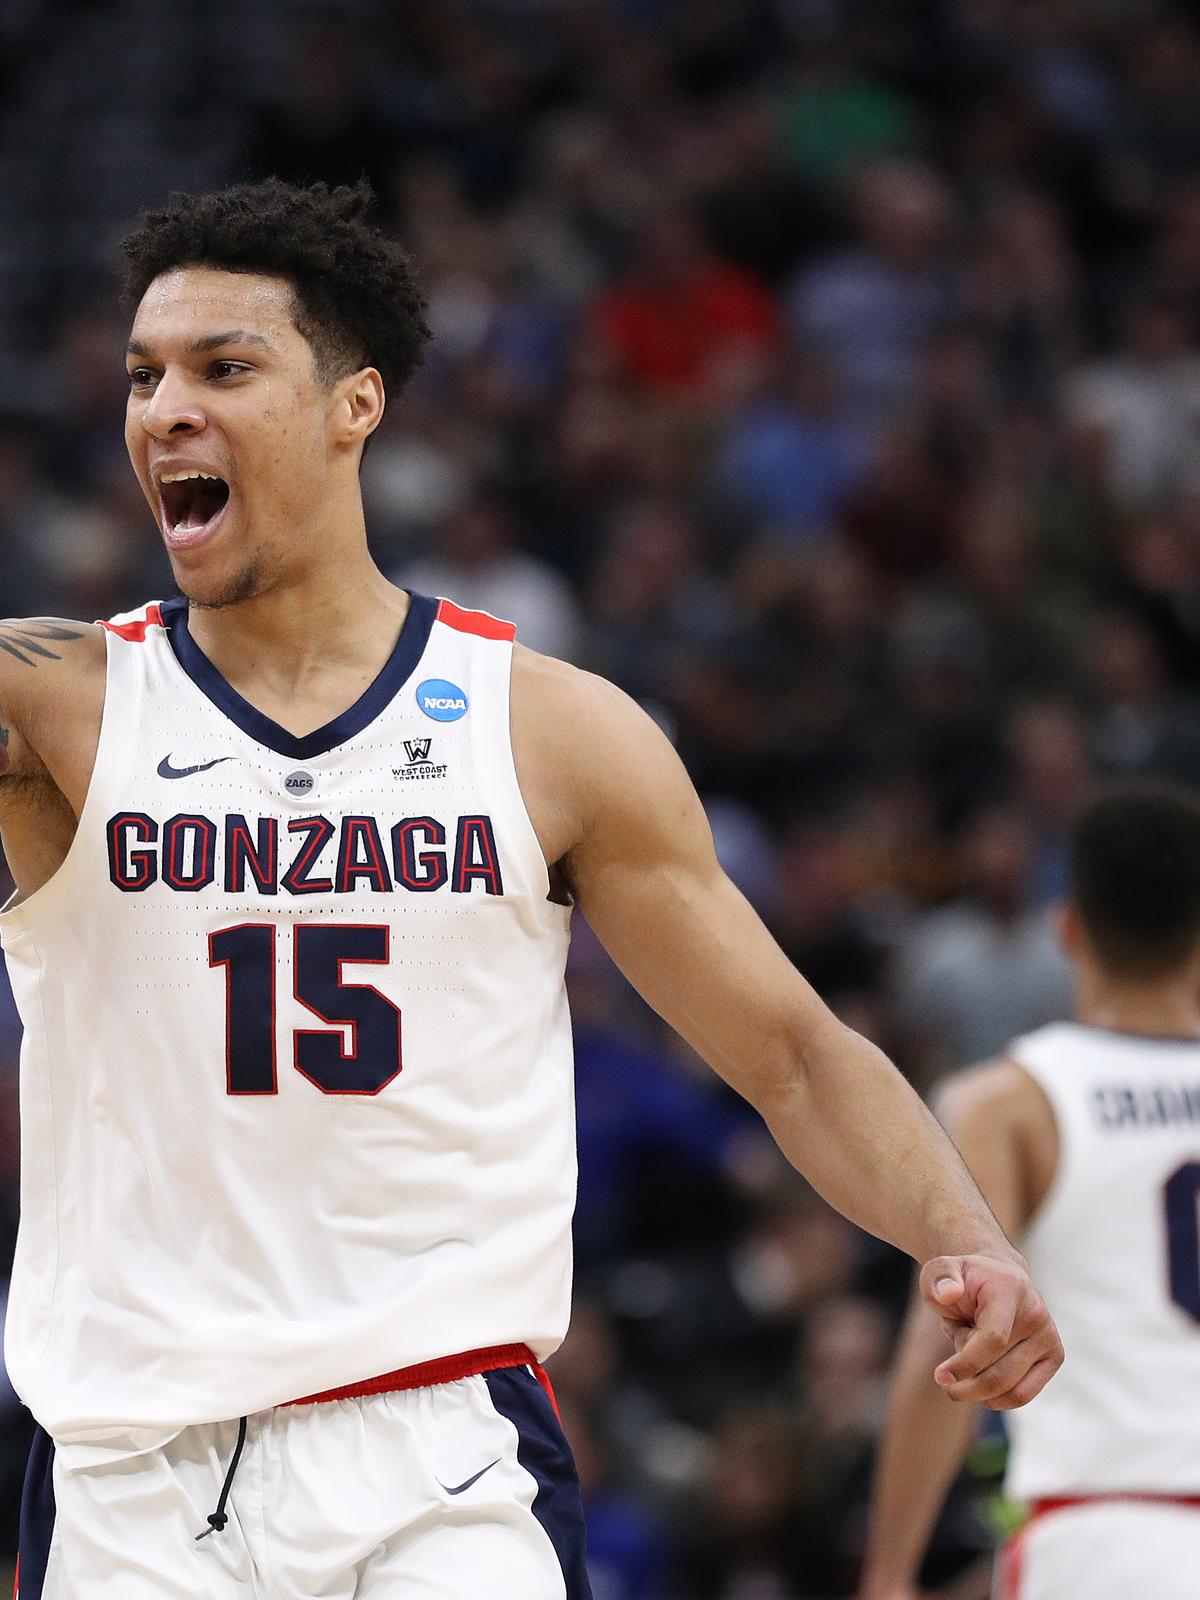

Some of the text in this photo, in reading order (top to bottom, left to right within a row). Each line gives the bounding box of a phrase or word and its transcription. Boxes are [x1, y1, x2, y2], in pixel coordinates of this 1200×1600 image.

[423, 696, 467, 711] NCAA
[391, 764, 448, 777] WEST COAST
[285, 778, 313, 789] ZAGS
[105, 811, 505, 897] GONZAGA
[207, 922, 403, 1096] 15
